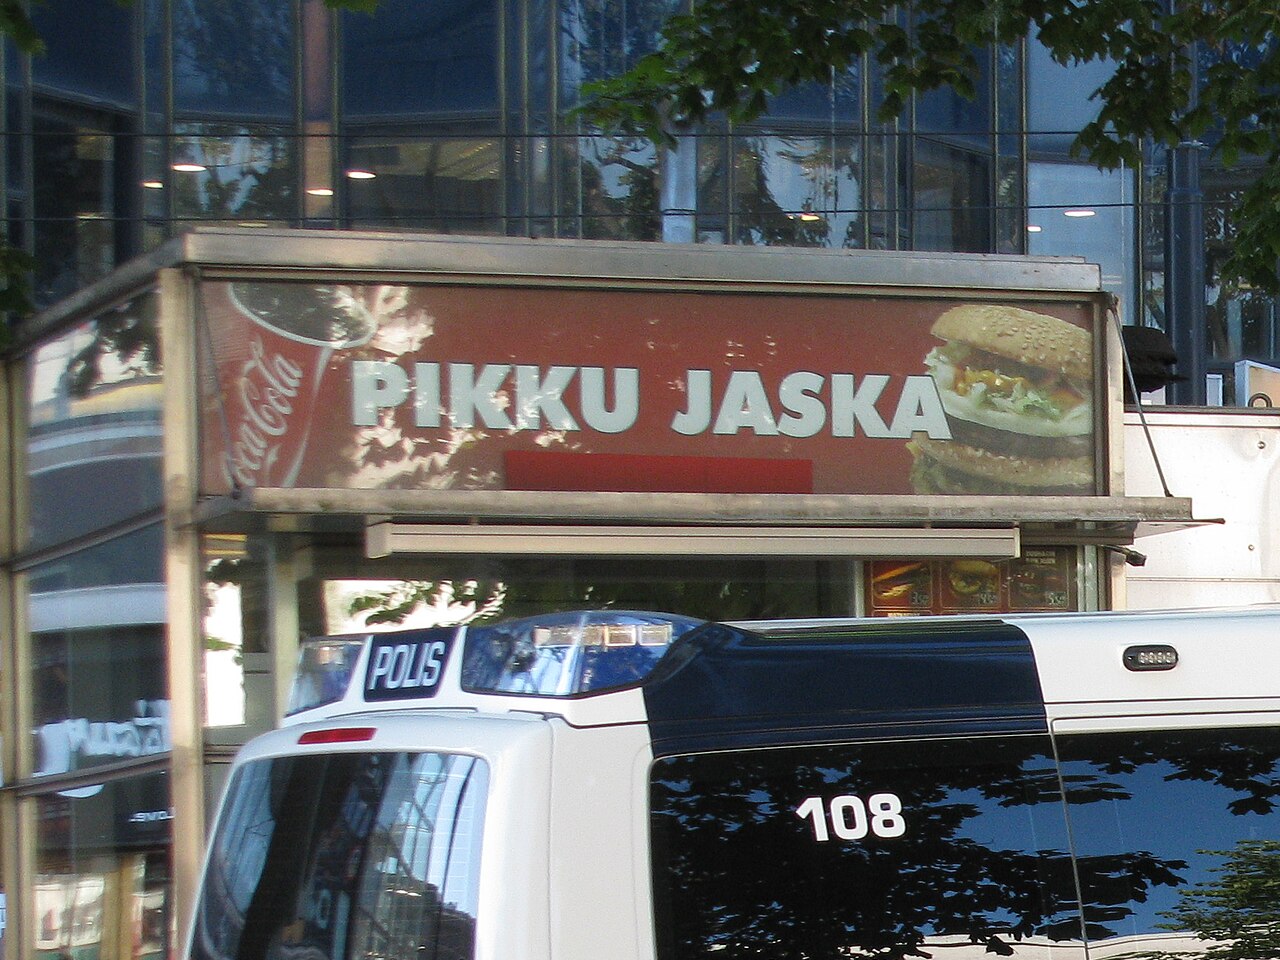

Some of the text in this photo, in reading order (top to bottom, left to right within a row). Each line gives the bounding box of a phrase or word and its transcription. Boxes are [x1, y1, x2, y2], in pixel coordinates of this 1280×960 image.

[352, 361, 952, 440] PIKKU JASKA
[368, 641, 446, 690] POLIS
[795, 793, 906, 841] 108
